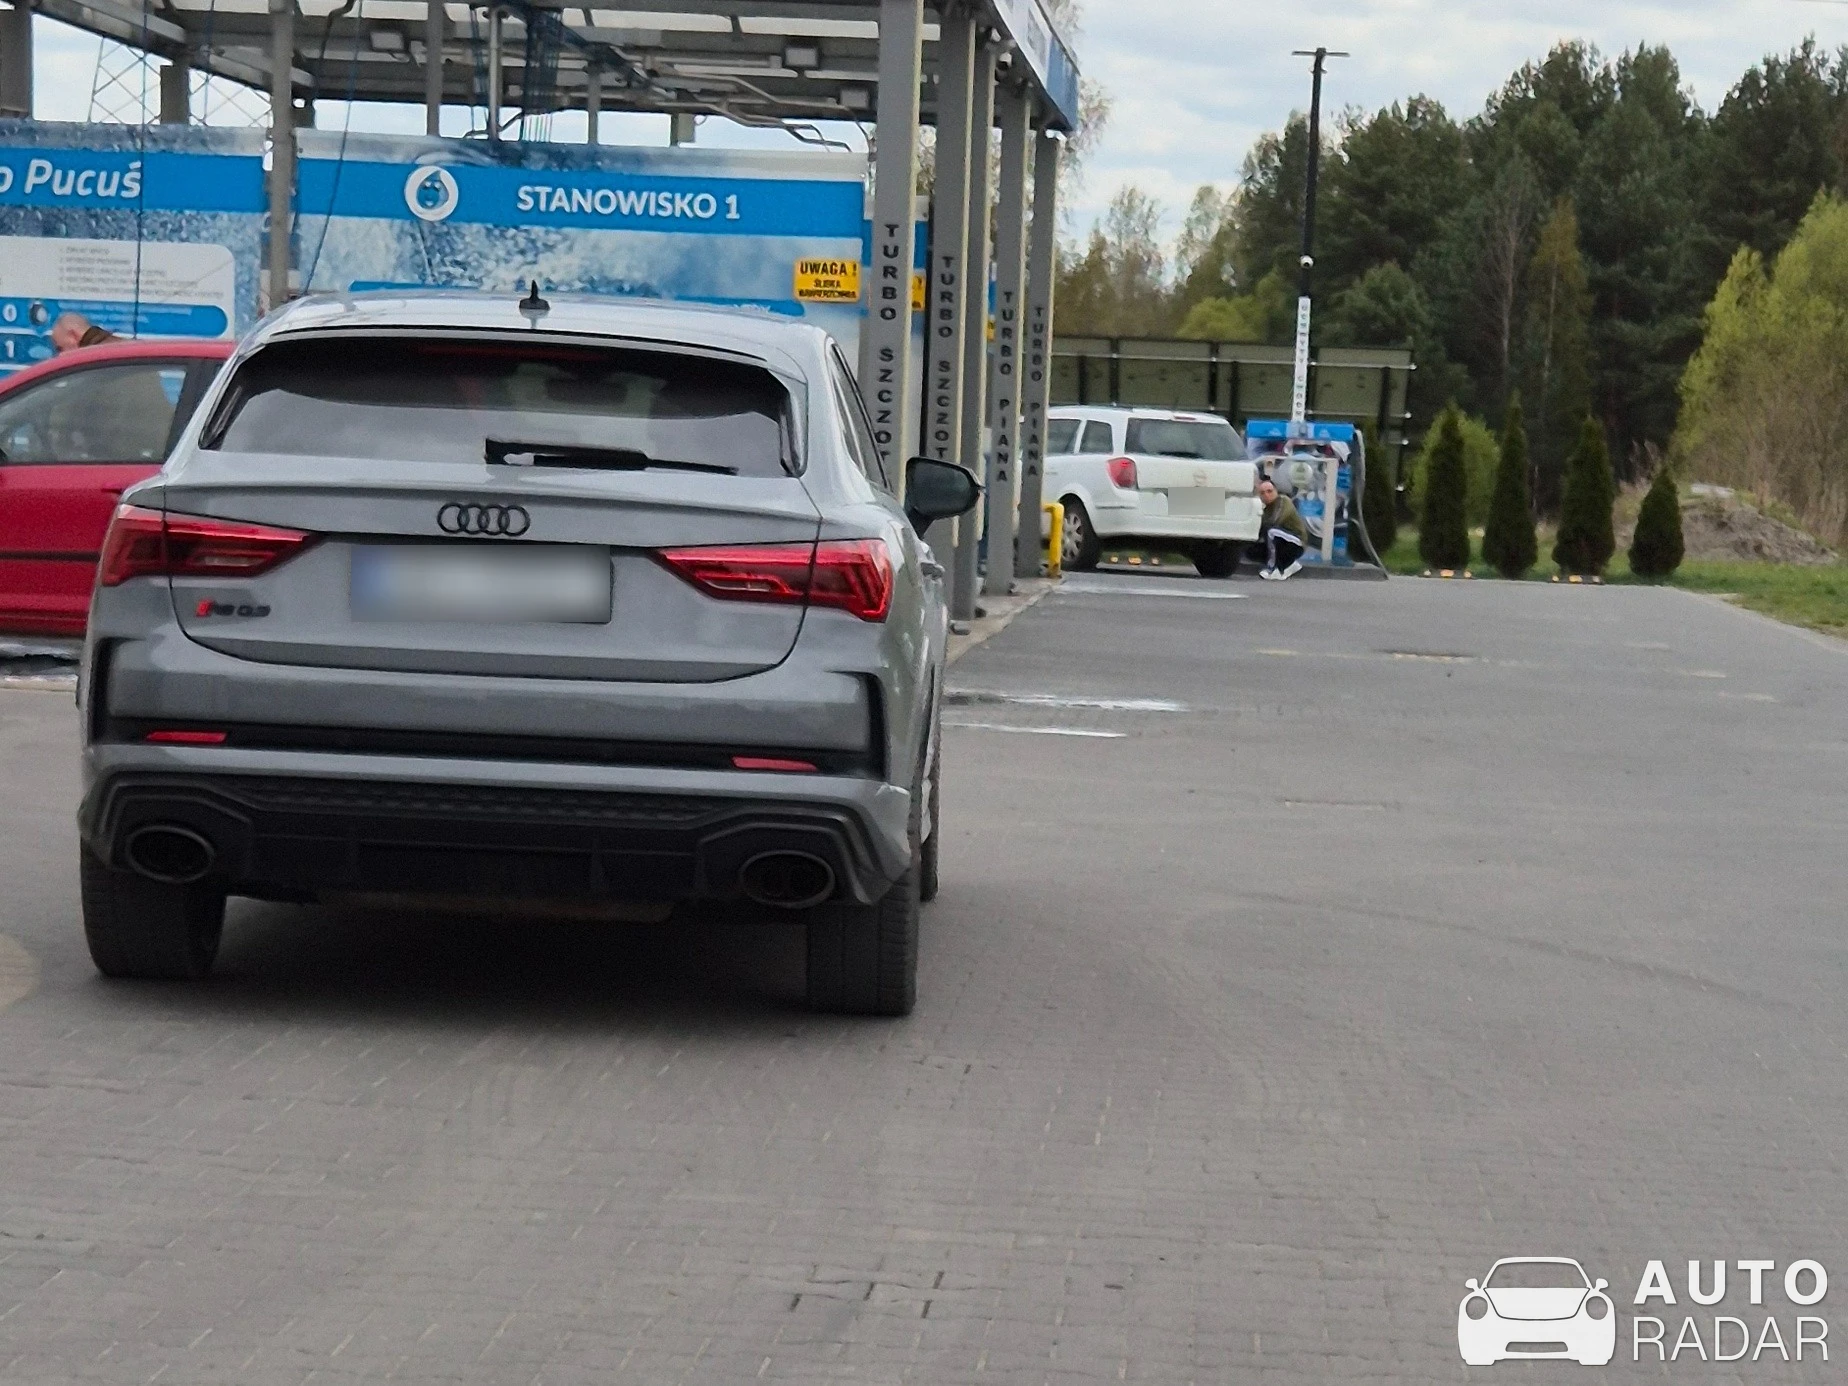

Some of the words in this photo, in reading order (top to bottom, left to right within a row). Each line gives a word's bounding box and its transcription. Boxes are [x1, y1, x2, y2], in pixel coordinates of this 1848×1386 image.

[24, 158, 142, 198] Pucuś
[517, 185, 717, 219] STANOWISKO
[725, 194, 740, 220] 1
[800, 261, 847, 275] UWAGA
[880, 224, 899, 320] TURBO
[938, 256, 955, 338] TURBO
[1000, 291, 1014, 375] TURBO
[1031, 306, 1044, 382] TURBO
[996, 399, 1009, 482] PIANA
[1028, 402, 1040, 476] PIANA
